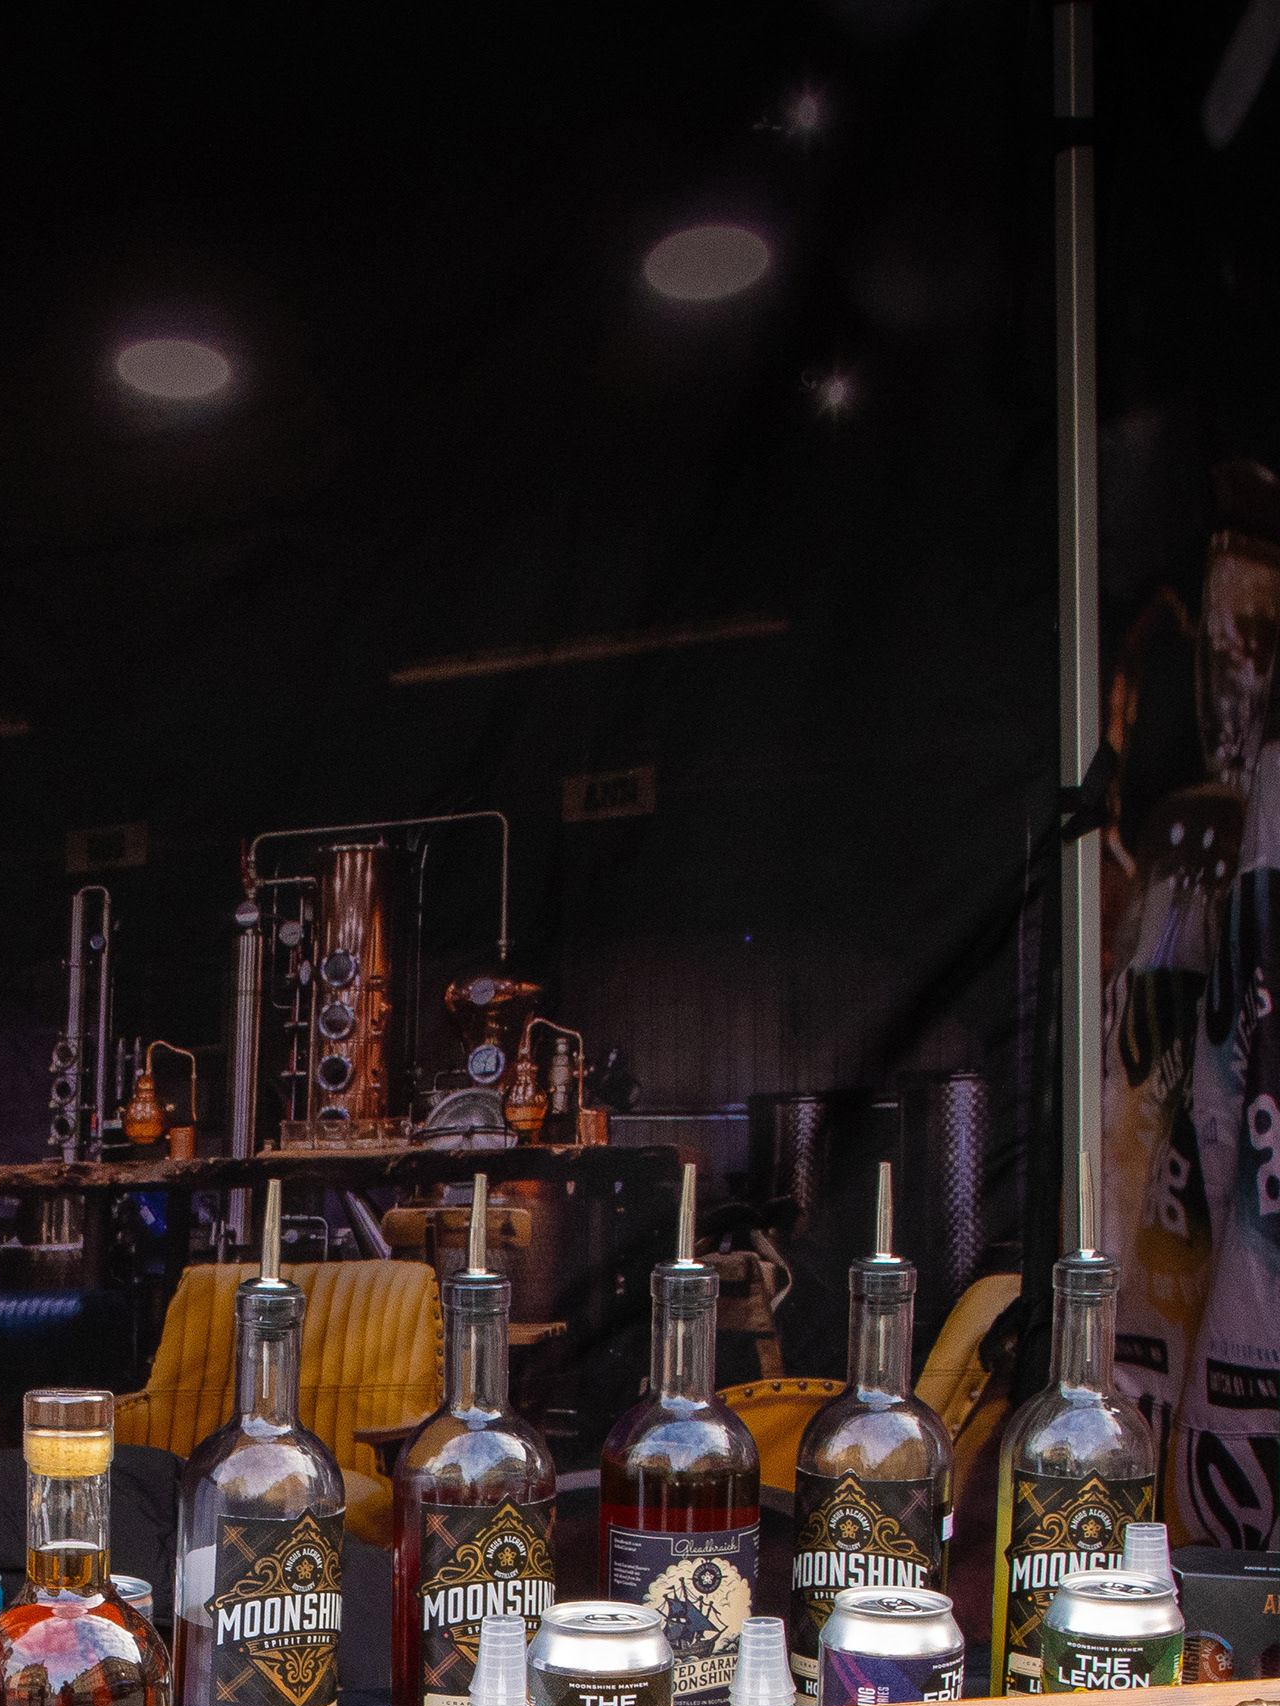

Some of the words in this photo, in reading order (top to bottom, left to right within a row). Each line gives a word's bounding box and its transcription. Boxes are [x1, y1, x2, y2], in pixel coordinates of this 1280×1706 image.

[792, 1552, 928, 1592] MOONSHINE
[1075, 1654, 1130, 1674] THE
[1058, 1666, 1150, 1690] LEMON
